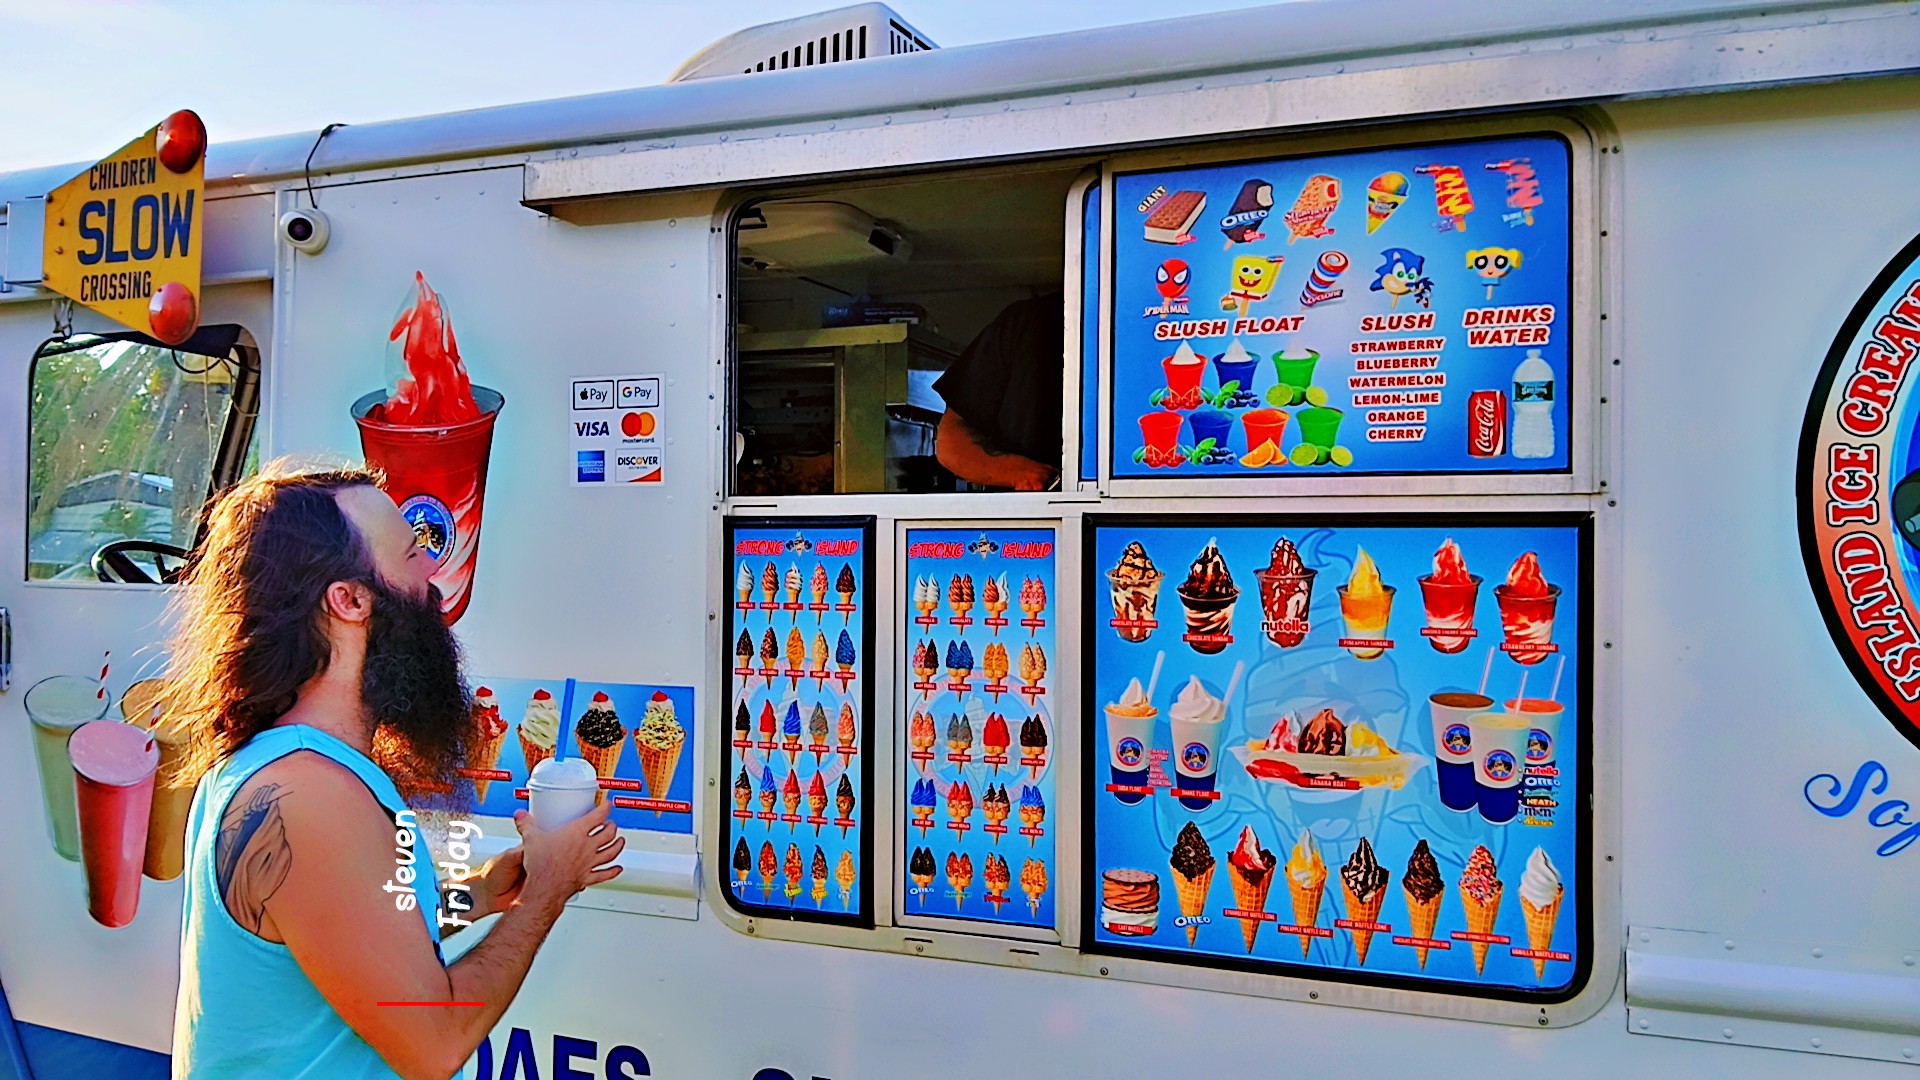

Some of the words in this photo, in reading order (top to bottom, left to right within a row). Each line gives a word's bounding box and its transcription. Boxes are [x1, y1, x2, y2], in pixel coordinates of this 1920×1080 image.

[90, 157, 156, 191] CHILDREN
[1137, 185, 1167, 213] GIANT
[1220, 209, 1269, 228] OREO
[77, 189, 195, 265] SLOW
[80, 270, 152, 301] CROSSING
[1361, 313, 1434, 331] SLUSH
[1464, 307, 1553, 325] DRINKS
[1156, 321, 1226, 338] SLUSH
[1234, 317, 1305, 334] FLOAT
[1470, 328, 1548, 345] WATER
[1351, 338, 1444, 353] STRAWBERRY
[1357, 356, 1438, 370] BLUEBERRY
[1350, 375, 1444, 388] WATERMELON
[590, 388, 608, 403] Pay
[634, 386, 652, 400] Pay
[1354, 392, 1440, 405] LEMON-LIME
[1368, 411, 1425, 422] ORANGE
[574, 421, 610, 436] VISA
[1368, 428, 1424, 440] CHERRY
[617, 456, 658, 466] DISCOVER
[1831, 447, 1876, 523] ICE
[736, 540, 784, 556] STRONG
[815, 540, 859, 556] ISLAND
[908, 542, 964, 559] STRONG
[1002, 542, 1053, 559] ISLAND
[1261, 620, 1309, 633] nutella
[1309, 779, 1332, 787] BANANA
[1526, 798, 1557, 807] HEATH
[1174, 916, 1212, 927] OREO
[1354, 921, 1373, 929] WAFFLE
[1374, 923, 1387, 931] CONE
[1511, 948, 1534, 957] VANILLA
[1555, 952, 1570, 960] CONE
